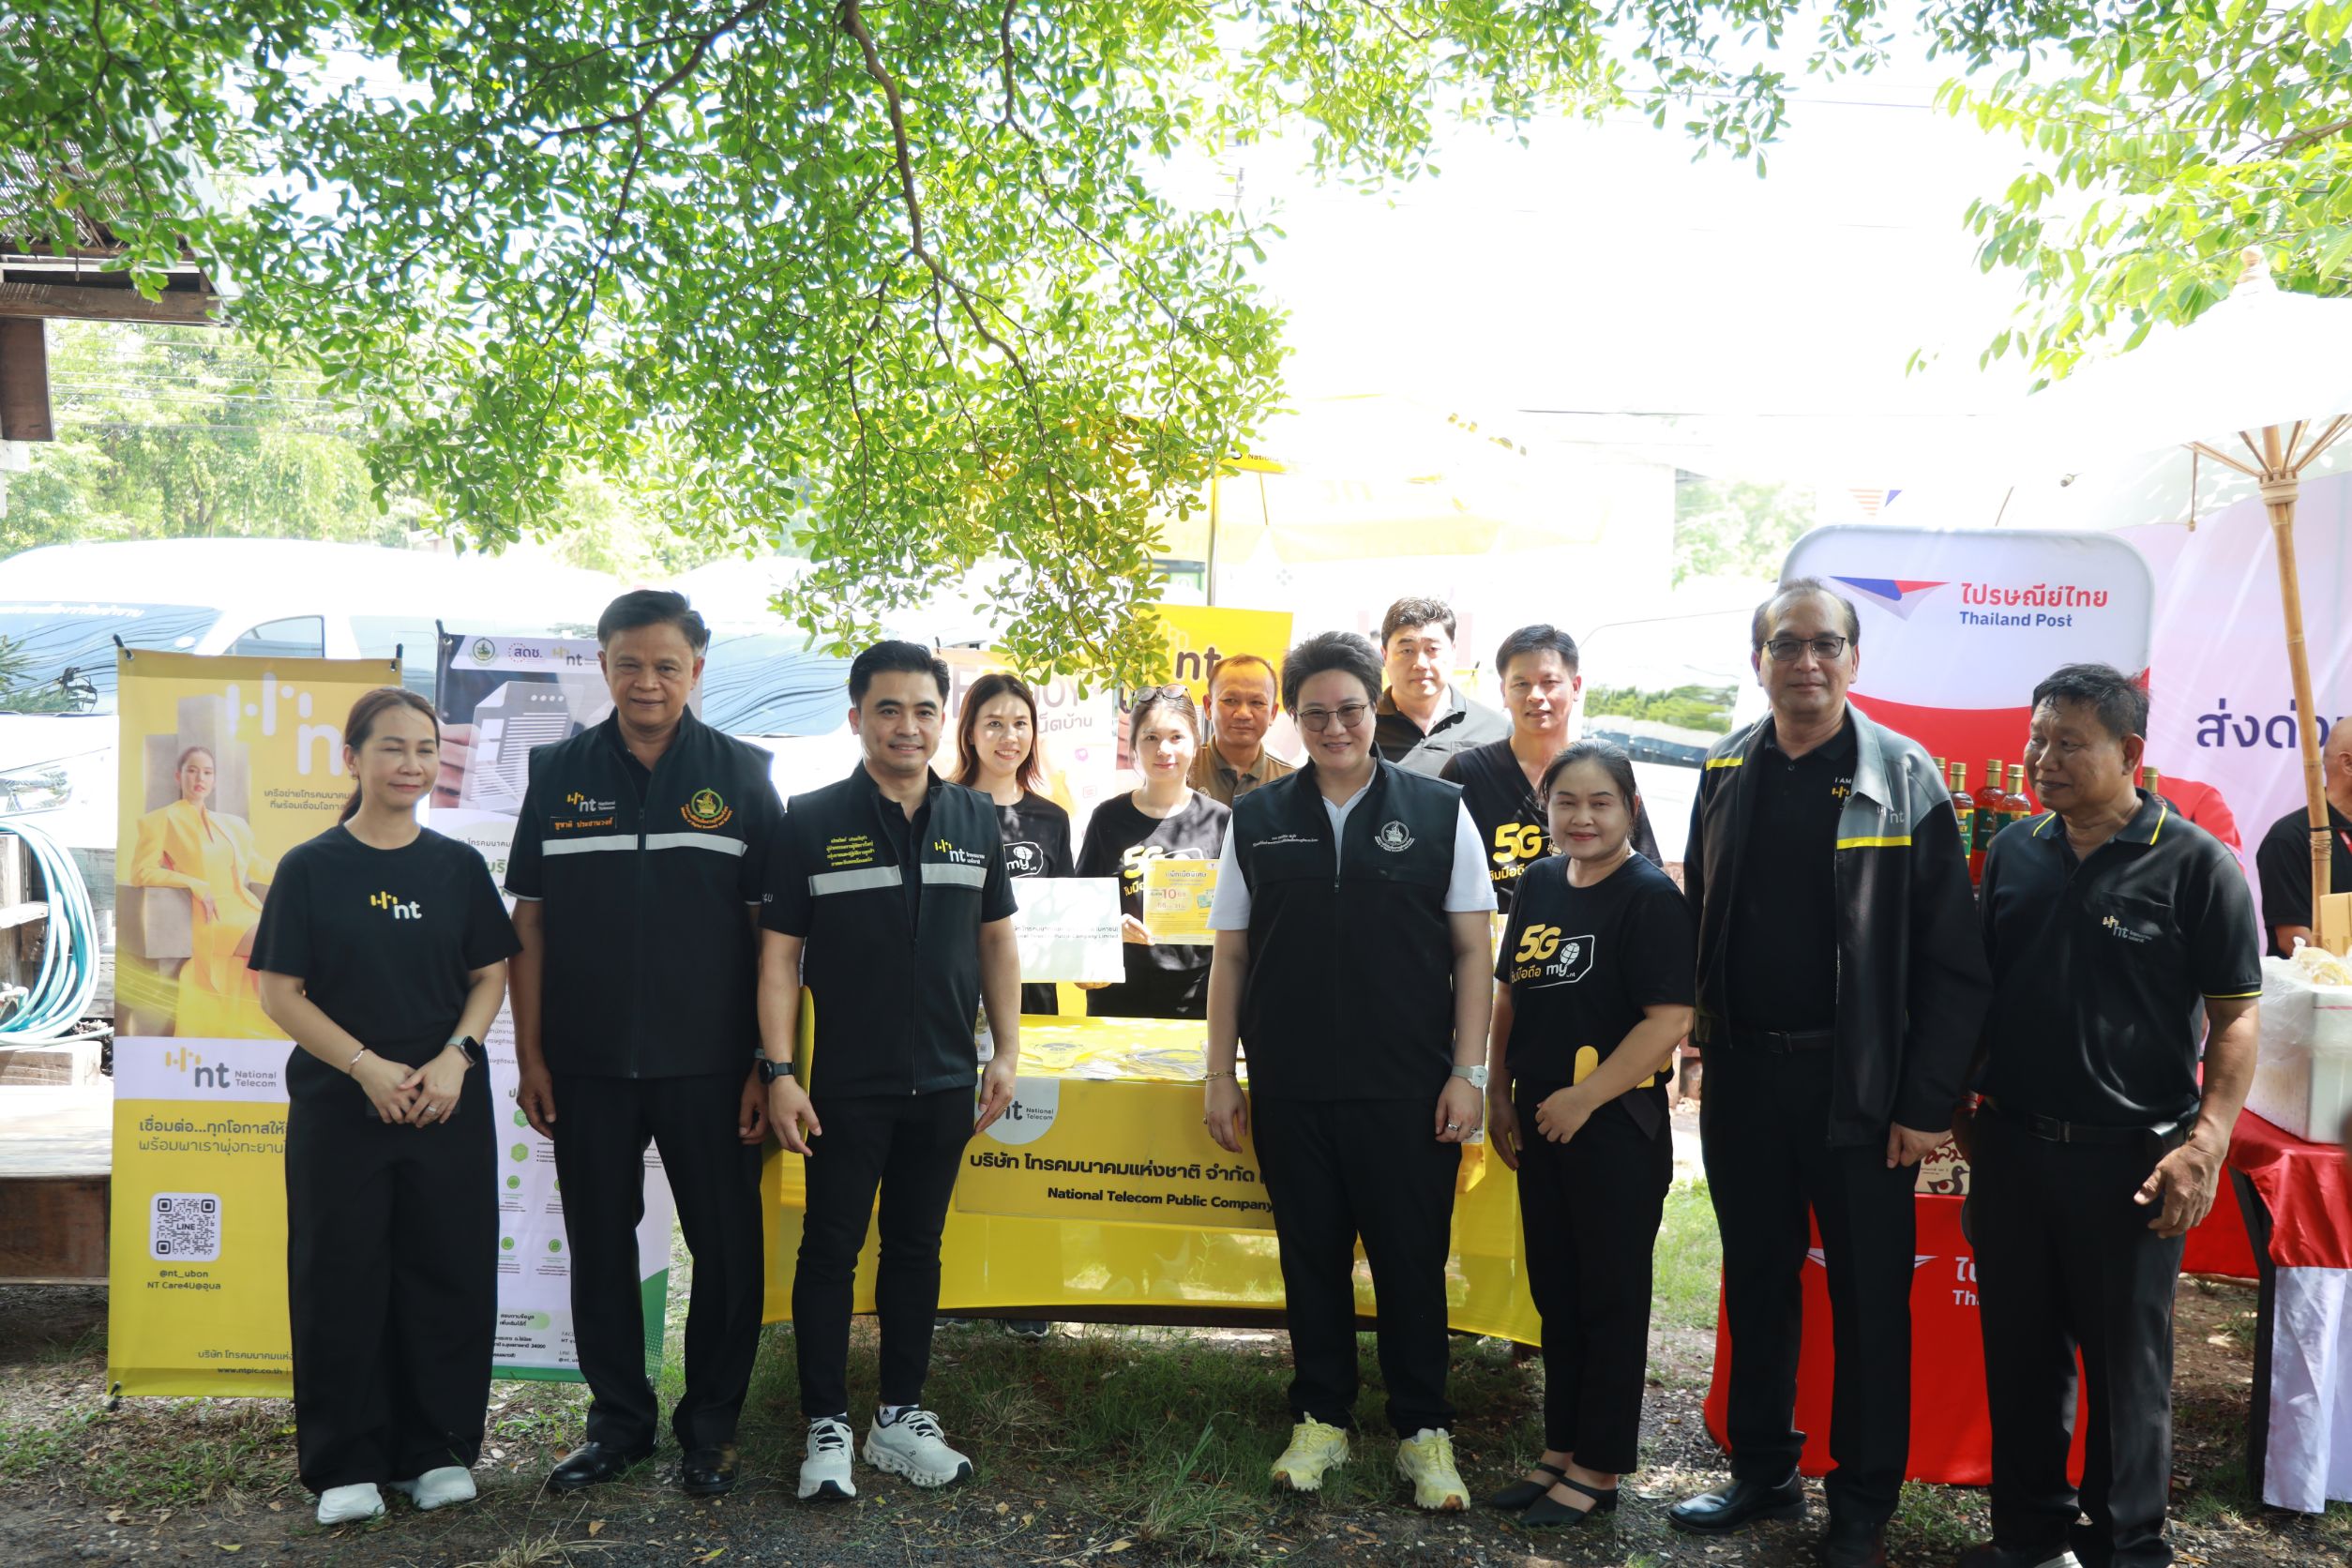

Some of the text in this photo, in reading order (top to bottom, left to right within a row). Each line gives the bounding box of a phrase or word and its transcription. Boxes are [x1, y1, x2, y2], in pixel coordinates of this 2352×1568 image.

[1961, 582, 2109, 608] ไปรษณีย์ไทย
[1959, 611, 2073, 627] Thailand Post
[565, 654, 582, 666] nt
[1175, 646, 1222, 681] nt
[579, 798, 597, 812] nt
[1890, 810, 1906, 823] nt
[1493, 822, 1543, 863] 5G
[949, 848, 966, 862] nt
[1006, 859, 1030, 870] my
[394, 900, 423, 920] nt
[1515, 924, 1561, 963] 5G
[1545, 963, 1568, 977] my
[194, 1063, 231, 1089] nt
[234, 1070, 277, 1079] National
[235, 1078, 277, 1088] Telecom
[970, 1152, 1255, 1183] บริษัท โทรคมนาคมแห่งชาติ จำกัด
[1048, 1186, 1273, 1213] National Telecom Public Company
[159, 1270, 209, 1278] @nt_ubon
